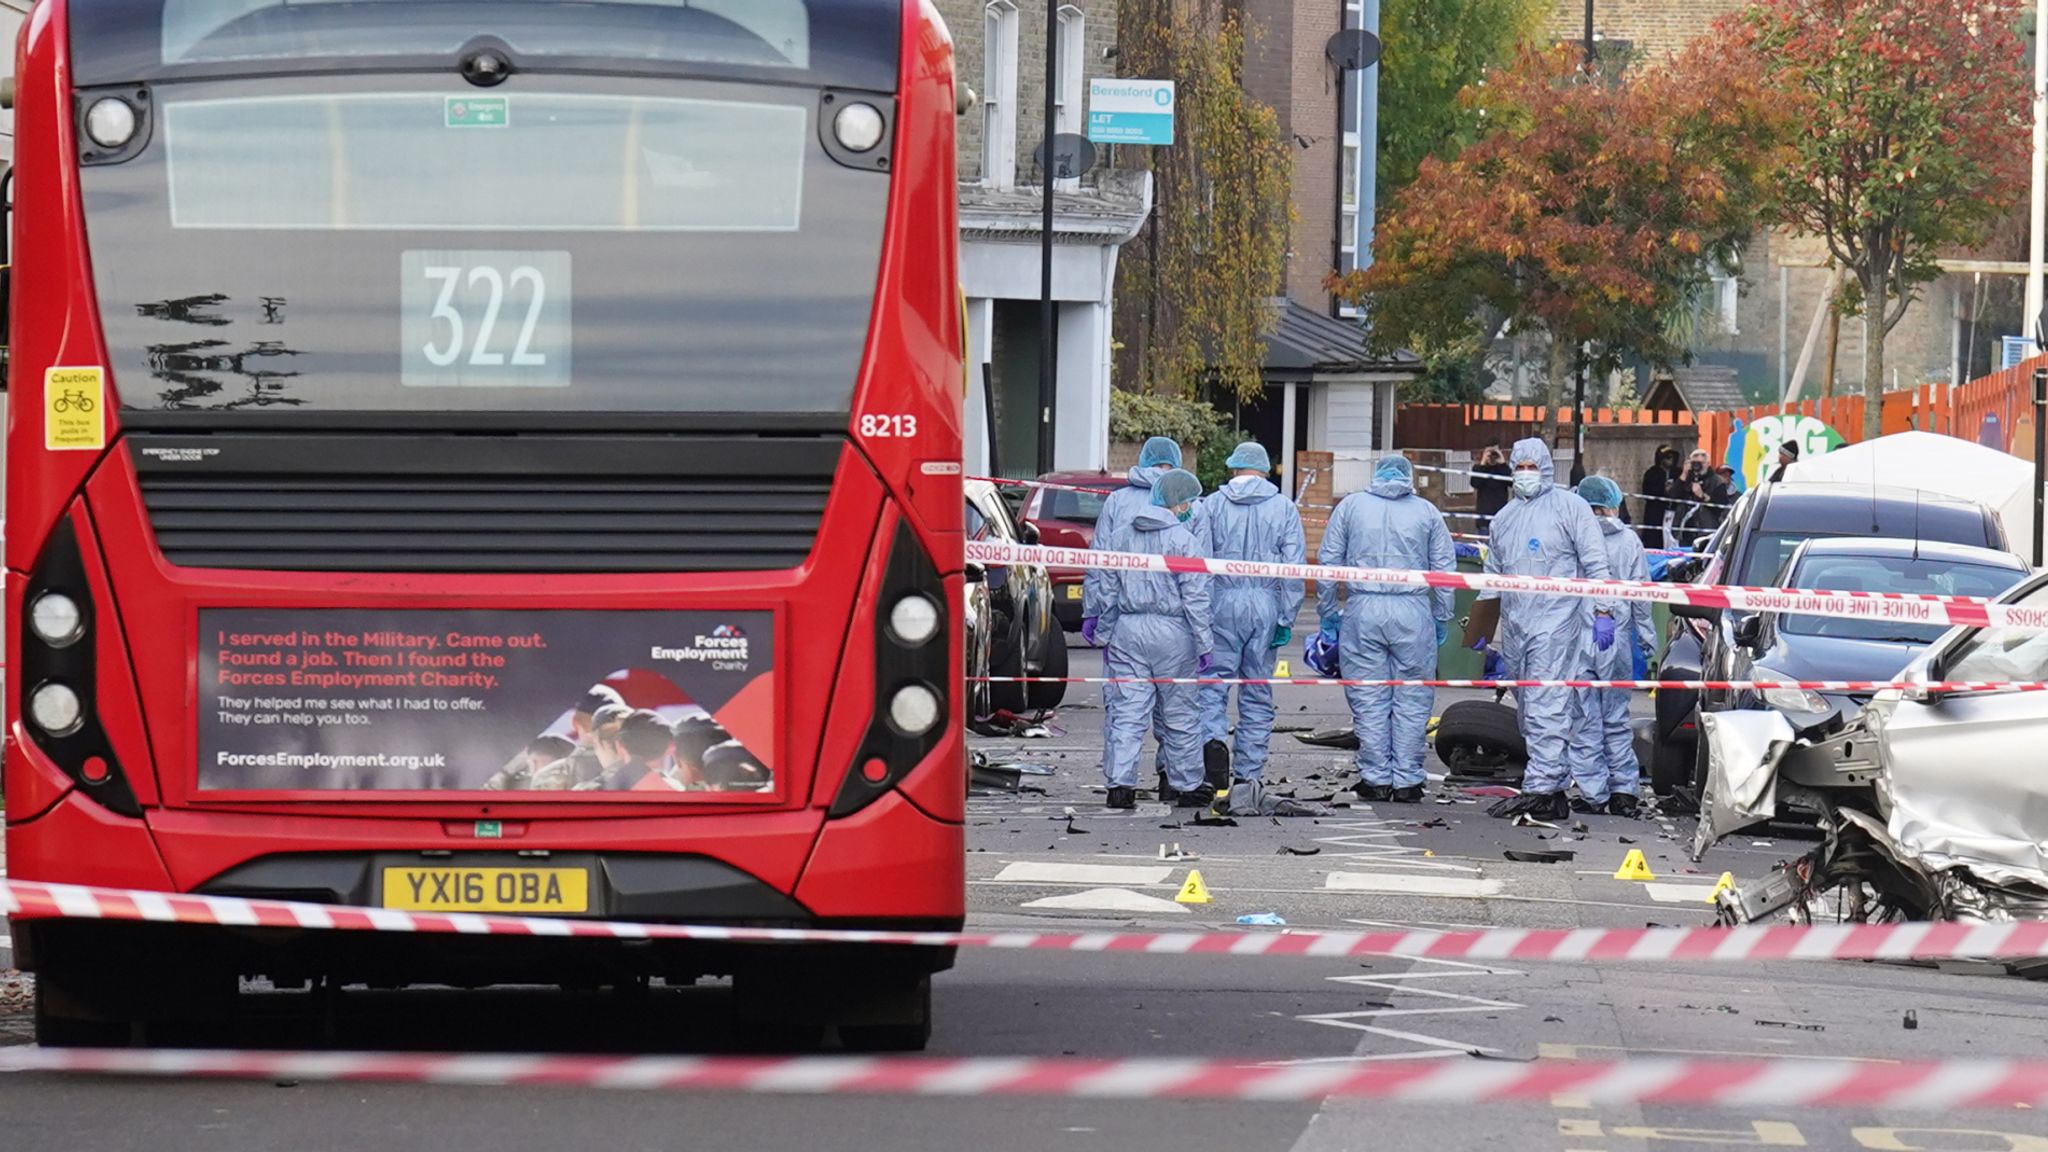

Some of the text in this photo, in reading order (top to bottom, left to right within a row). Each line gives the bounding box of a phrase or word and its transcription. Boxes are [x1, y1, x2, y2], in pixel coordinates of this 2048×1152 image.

[1092, 86, 1152, 97] Beresford
[1092, 114, 1113, 124] LET
[422, 265, 546, 366] 322
[51, 373, 97, 383] Caution
[861, 414, 917, 437] 8213
[1750, 416, 1828, 456] BIG
[966, 543, 1150, 569] POLICE LINE DO NOT CROSS
[1745, 594, 1929, 619] POLICE LINE DO NOT CROSS
[2006, 608, 2048, 627] CROSS
[218, 631, 548, 650] I served in the Military. Came out.
[695, 635, 748, 648] Forces
[218, 651, 505, 669] Found a job. Then I found the
[651, 646, 748, 662] Employment
[712, 660, 749, 672] Charity
[218, 670, 499, 689] Forces Employment Charity.
[217, 696, 486, 711] They helped me see what I had to offer.
[217, 711, 371, 726] They can help you too.
[217, 752, 445, 770] ForcesEmployment.org.uk
[1637, 861, 1644, 871] 4
[407, 873, 562, 904] YX16 OBA
[1188, 883, 1196, 894] 2
